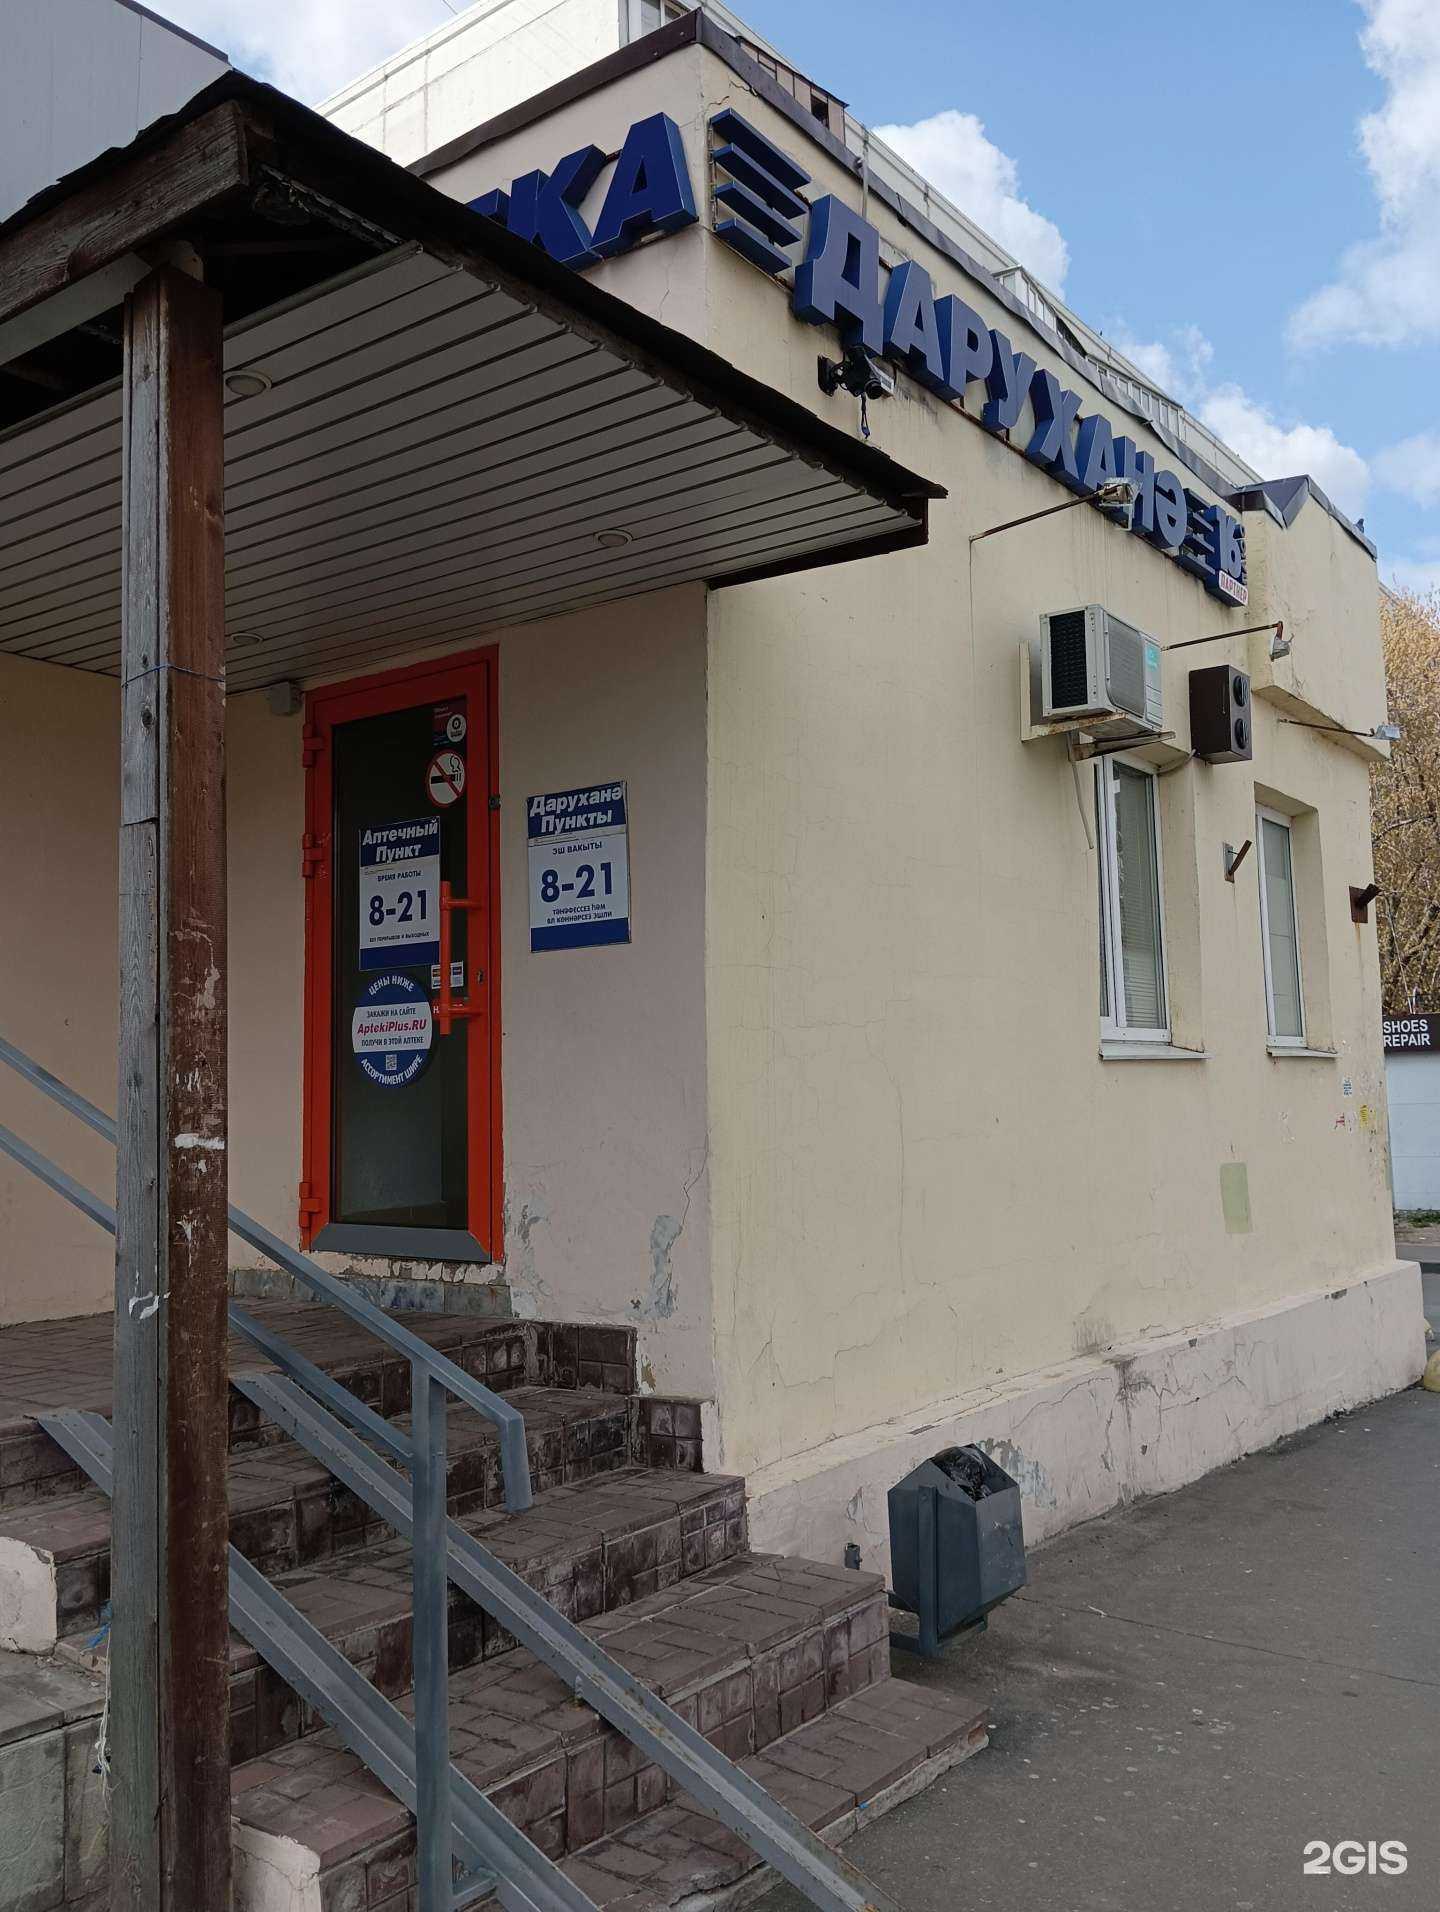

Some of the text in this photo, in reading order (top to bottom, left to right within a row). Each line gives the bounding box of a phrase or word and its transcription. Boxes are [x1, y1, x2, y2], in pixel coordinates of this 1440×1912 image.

[465, 111, 698, 272] КА
[530, 786, 623, 817] Даруханә
[363, 819, 438, 845] Аптечный
[541, 809, 613, 835] Пункты
[376, 844, 422, 864] Пункт
[567, 841, 602, 853] ВАКЫТЫ
[377, 870, 422, 882] ВРЕМЯ РАБОТЫ
[541, 862, 612, 903] 8-21
[369, 889, 427, 926] 8-21
[368, 975, 415, 995] ЦЕНЫ НИЖЕ
[367, 1006, 416, 1018] ЗАКАЖИ НА САЙТЕ
[357, 1019, 427, 1037] AptekiPlus.RU
[1383, 1019, 1428, 1033] SHOES
[361, 1038, 382, 1047] ПОЛУЧИ
[388, 1035, 402, 1046] ЭТОЙ
[403, 1036, 424, 1045] АПТЕКЕ
[1383, 1033, 1431, 1047] REPAIR
[361, 1054, 423, 1085] АССОРТИМЕНТ ШИРЕ
